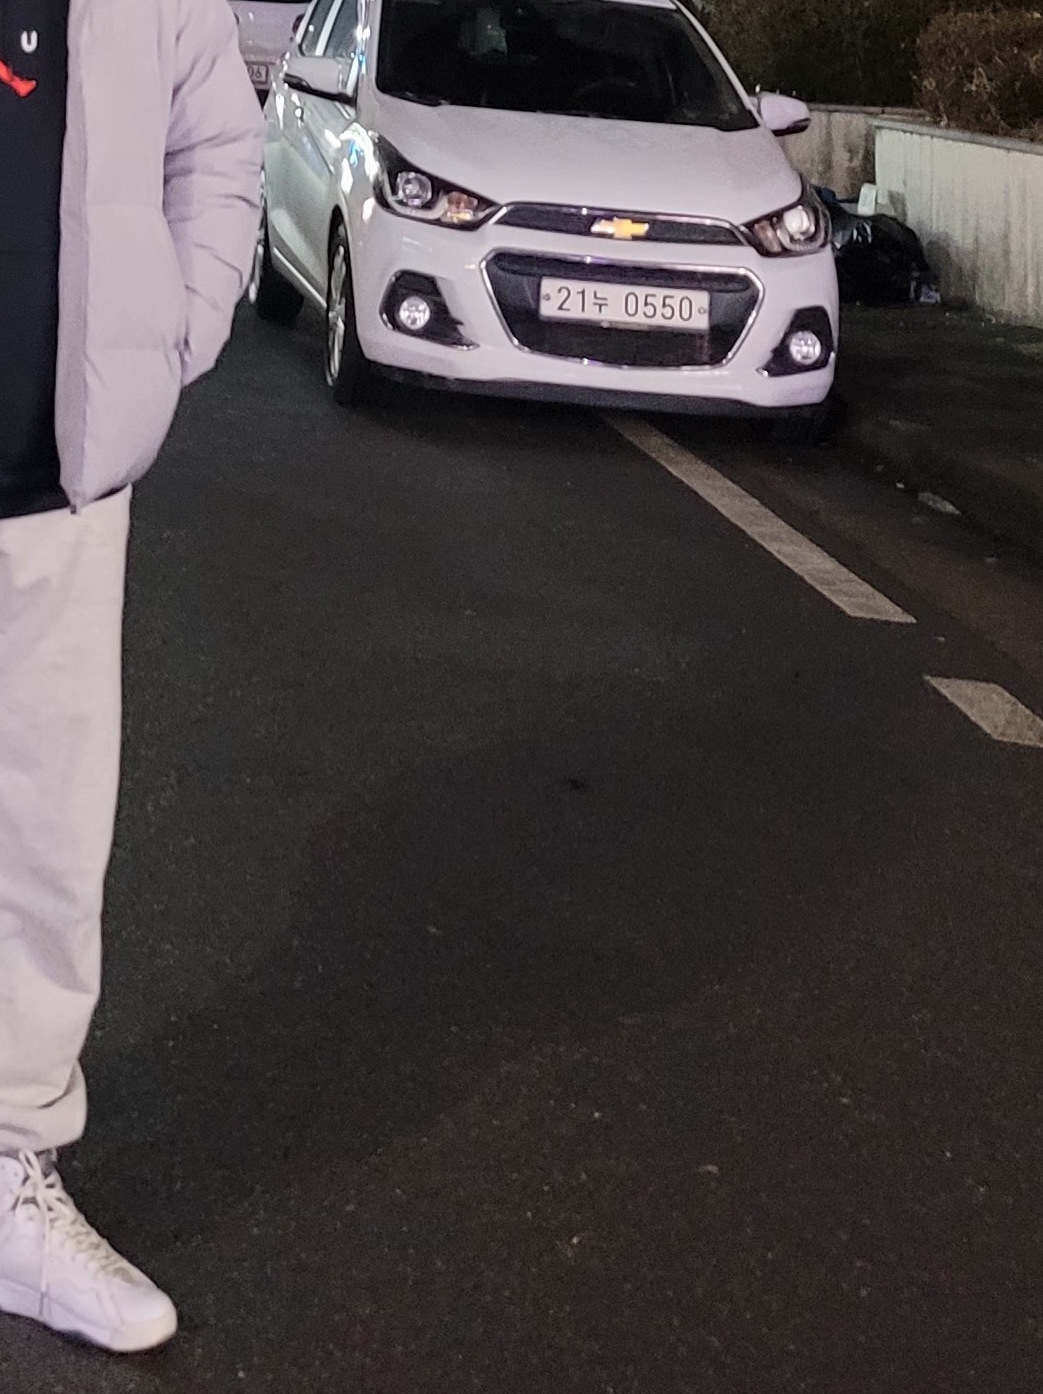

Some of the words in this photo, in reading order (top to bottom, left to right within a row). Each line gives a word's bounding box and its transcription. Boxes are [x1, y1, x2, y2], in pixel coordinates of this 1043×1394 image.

[20, 29, 39, 54] U
[555, 285, 611, 314] 21누
[624, 292, 696, 323] 0550
